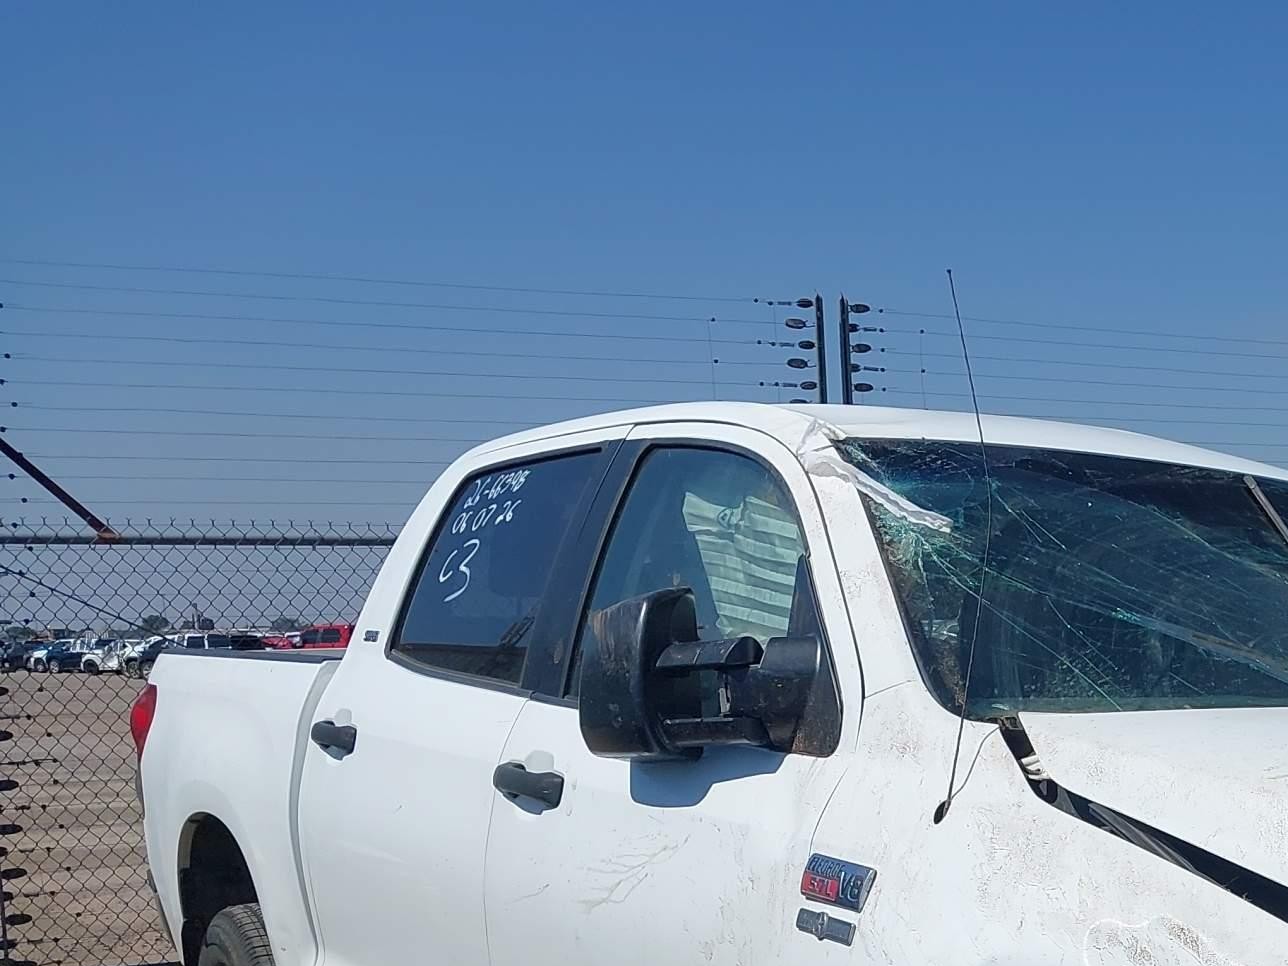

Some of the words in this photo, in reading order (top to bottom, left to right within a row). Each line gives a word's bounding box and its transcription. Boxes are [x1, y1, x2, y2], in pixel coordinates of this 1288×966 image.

[452, 510, 474, 535] 06
[471, 507, 498, 532] 07
[494, 499, 522, 525] 26
[438, 538, 481, 603] C3
[839, 871, 865, 902] V8
